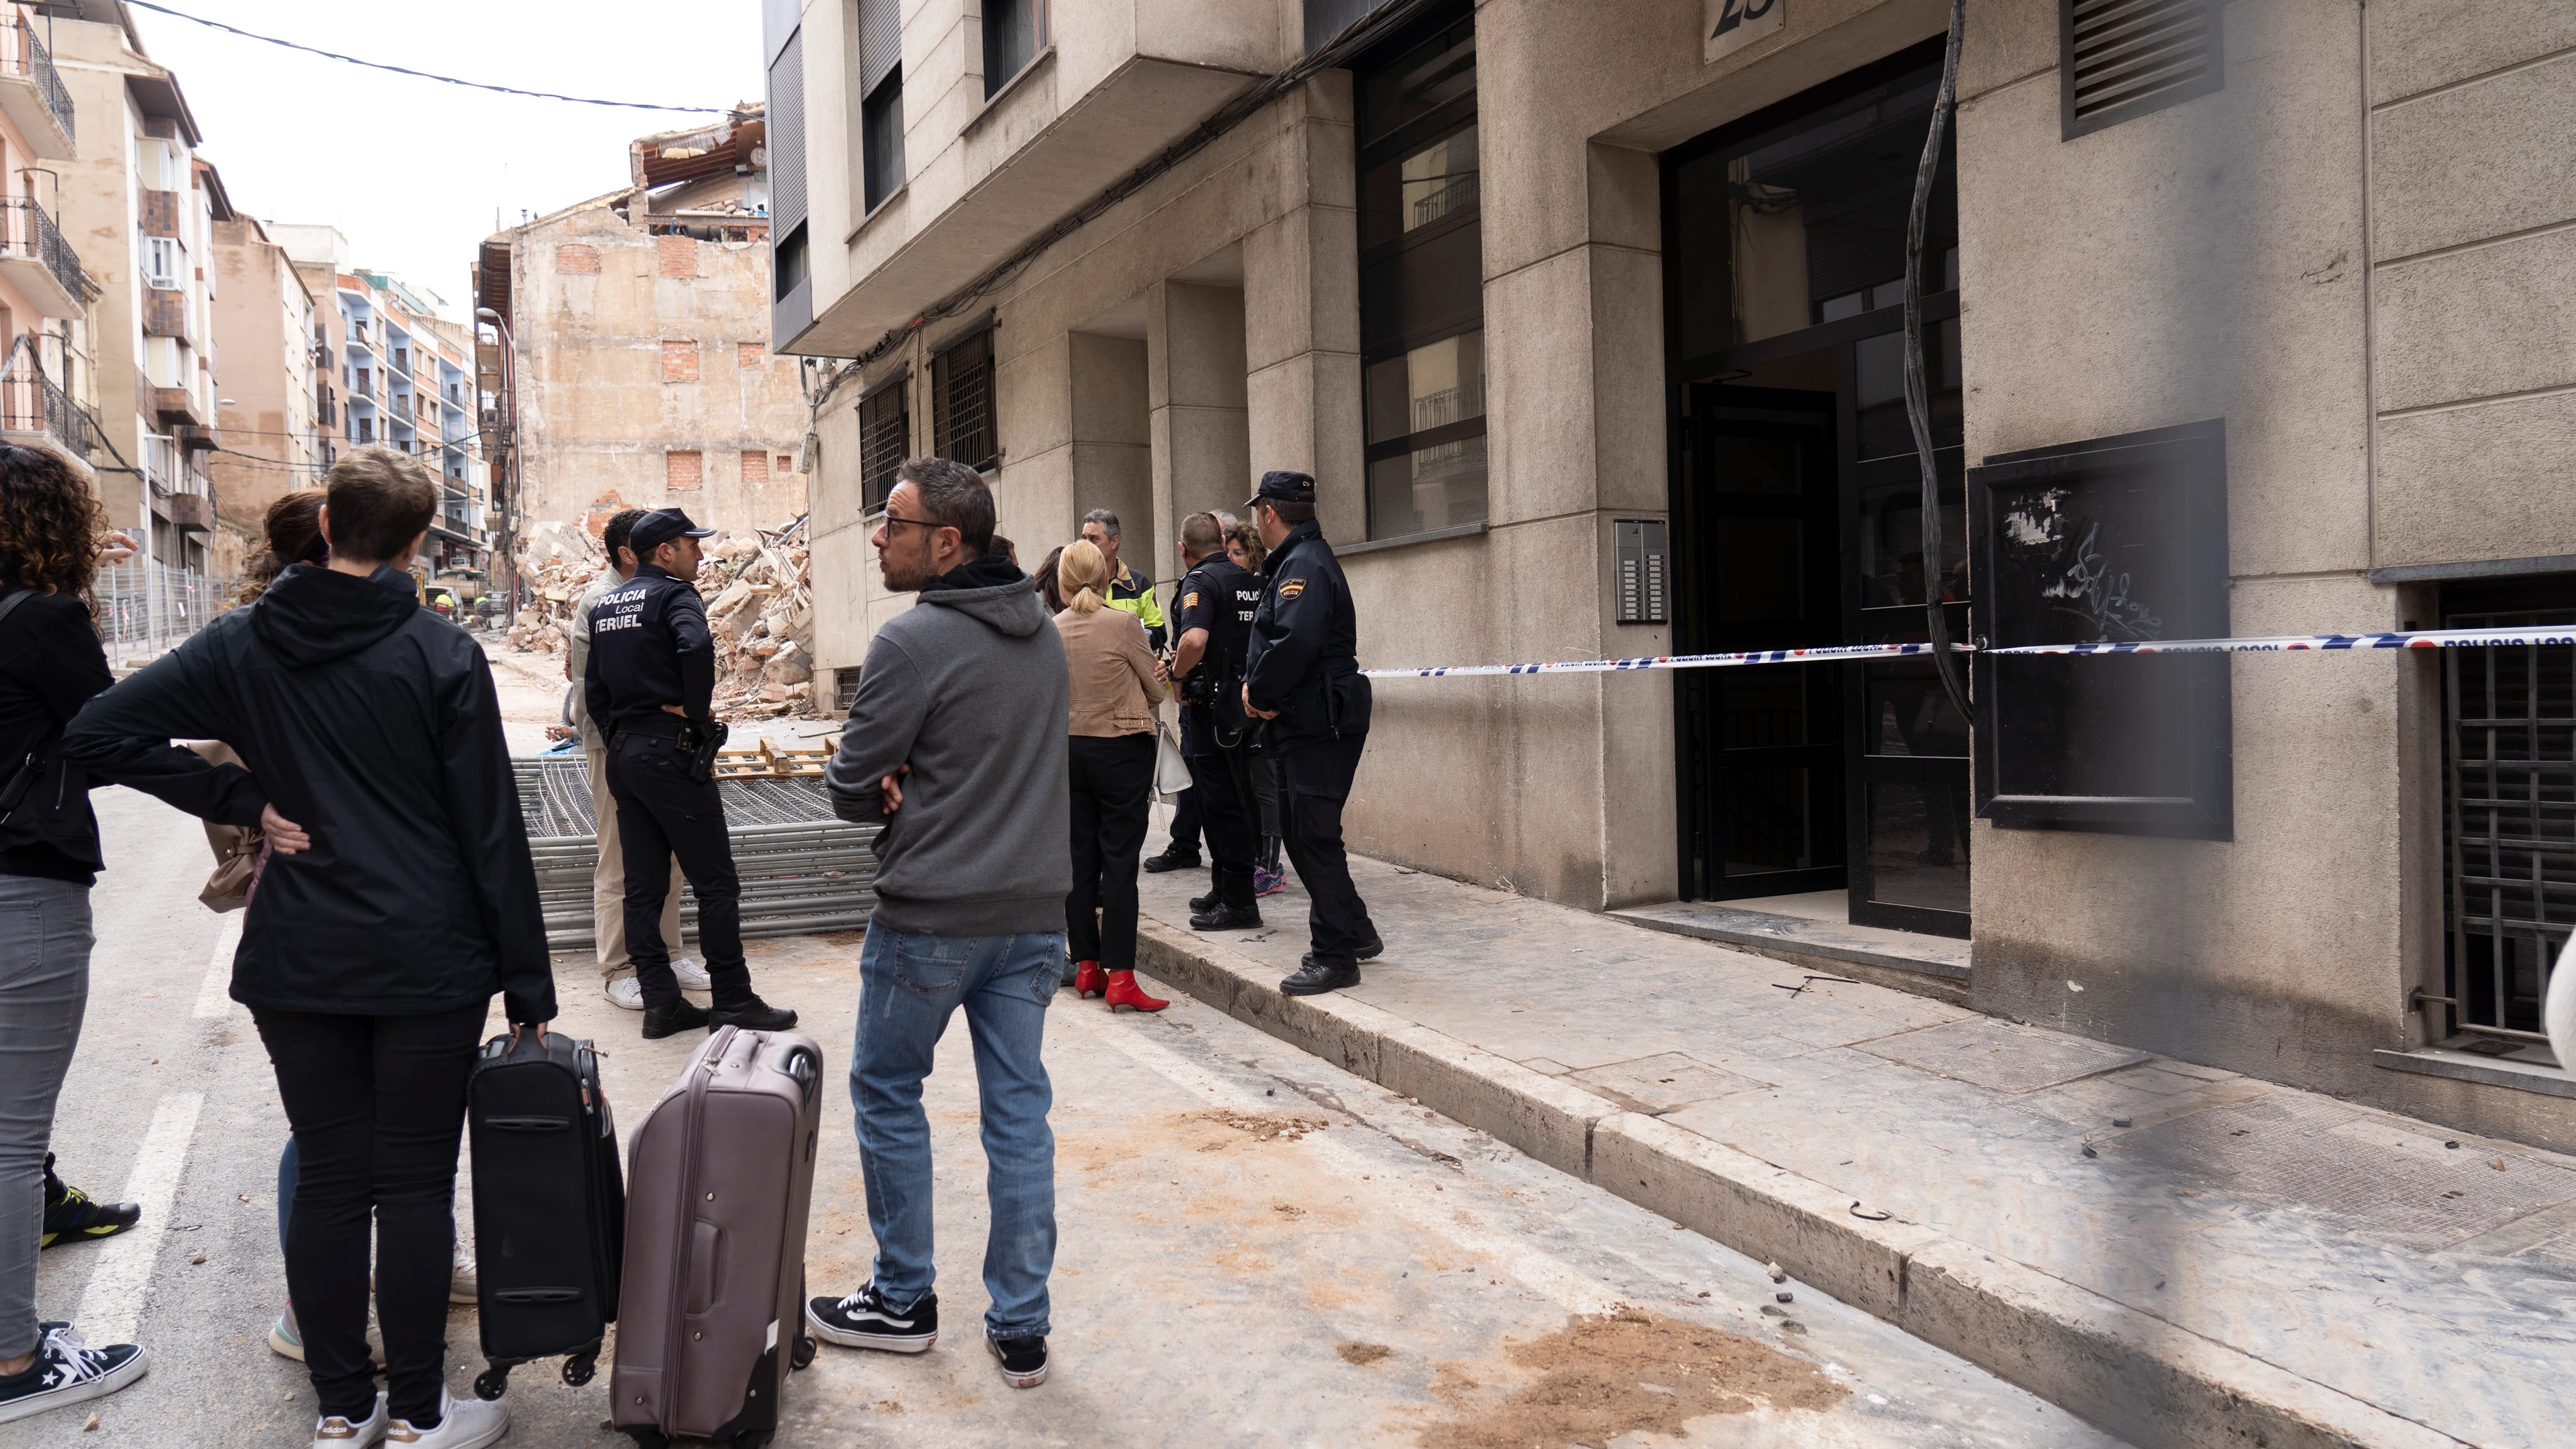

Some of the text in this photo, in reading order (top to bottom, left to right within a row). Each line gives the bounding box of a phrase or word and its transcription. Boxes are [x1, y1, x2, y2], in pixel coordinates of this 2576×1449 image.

[597, 589, 647, 608] POLICIA
[1236, 590, 1261, 601] POLIC
[615, 602, 644, 614] Local
